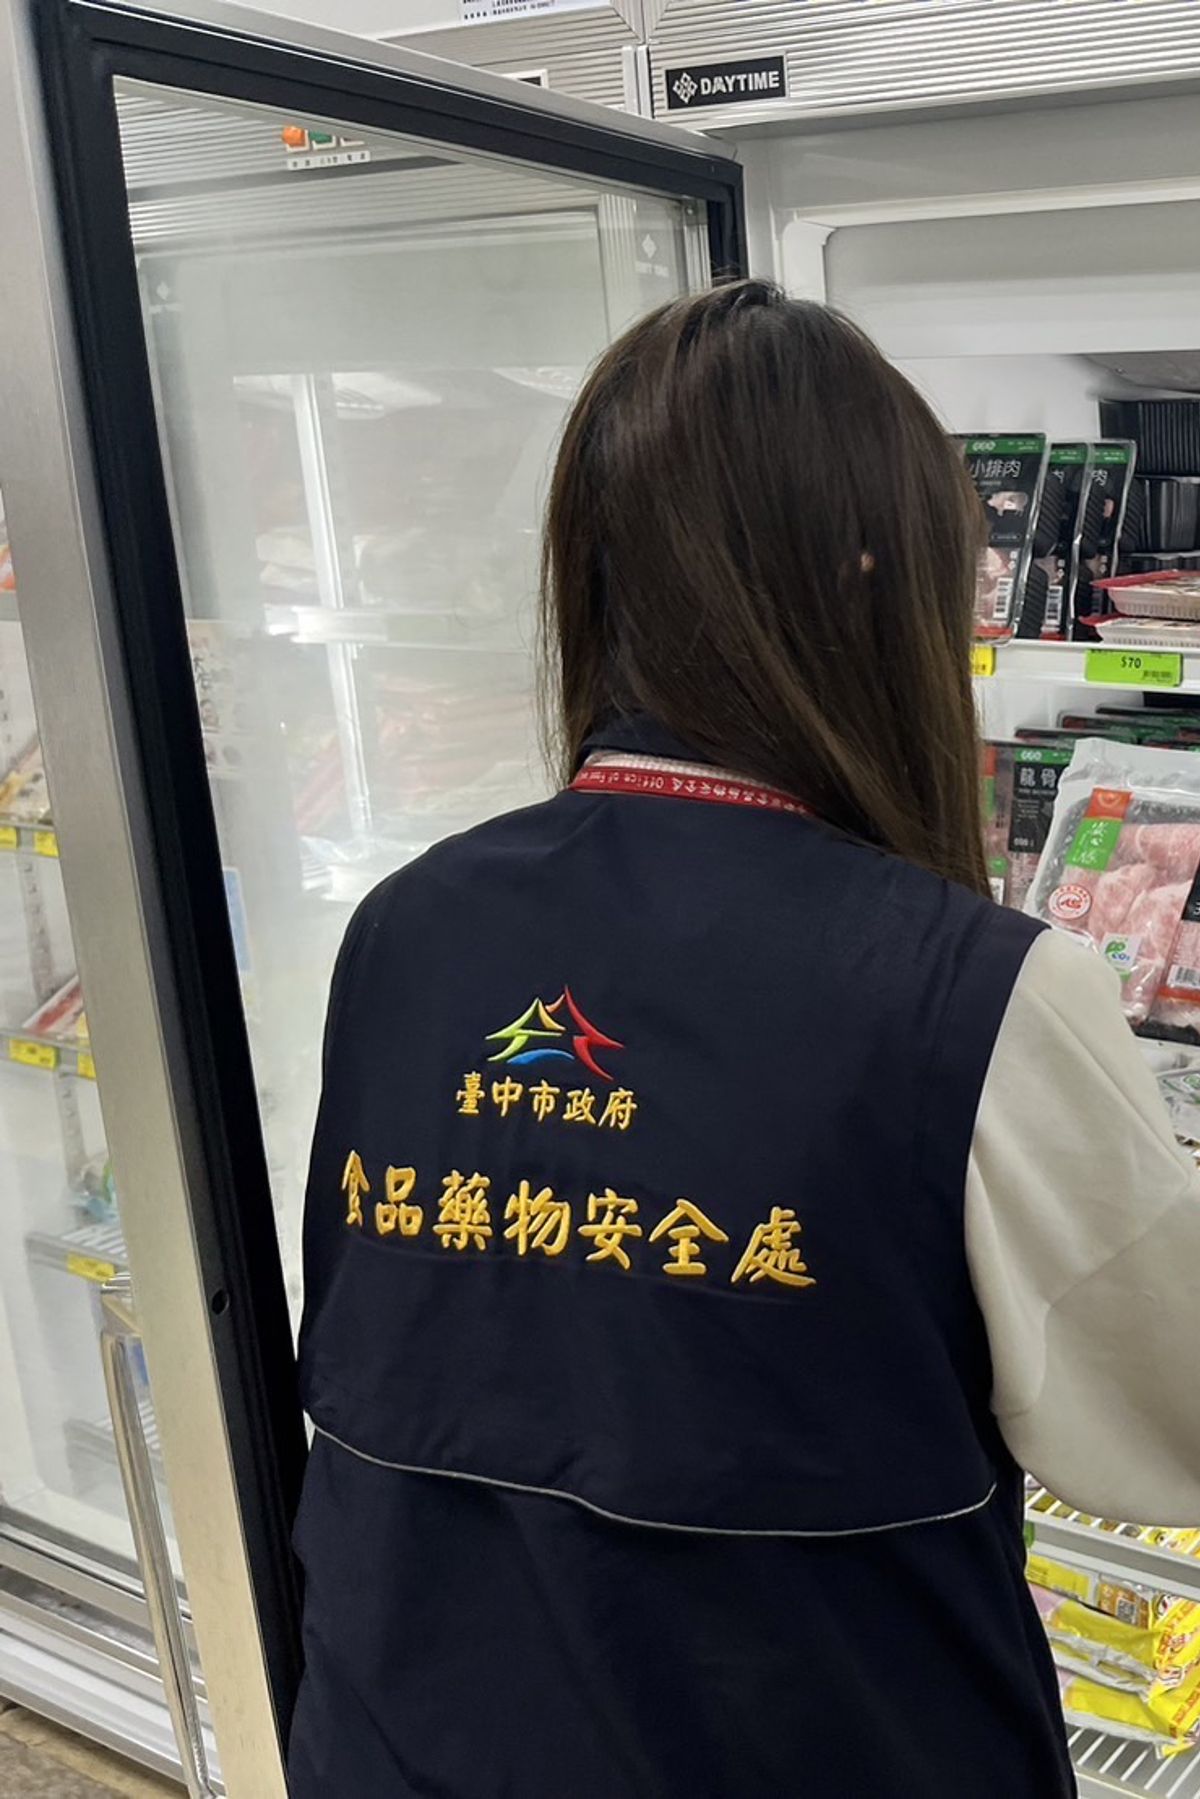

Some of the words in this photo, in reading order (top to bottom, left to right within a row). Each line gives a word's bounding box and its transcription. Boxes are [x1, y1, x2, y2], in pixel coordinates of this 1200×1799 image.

[701, 71, 780, 96] DAYTIME
[1120, 656, 1142, 669] $70
[455, 1070, 637, 1131] 臺中市政府
